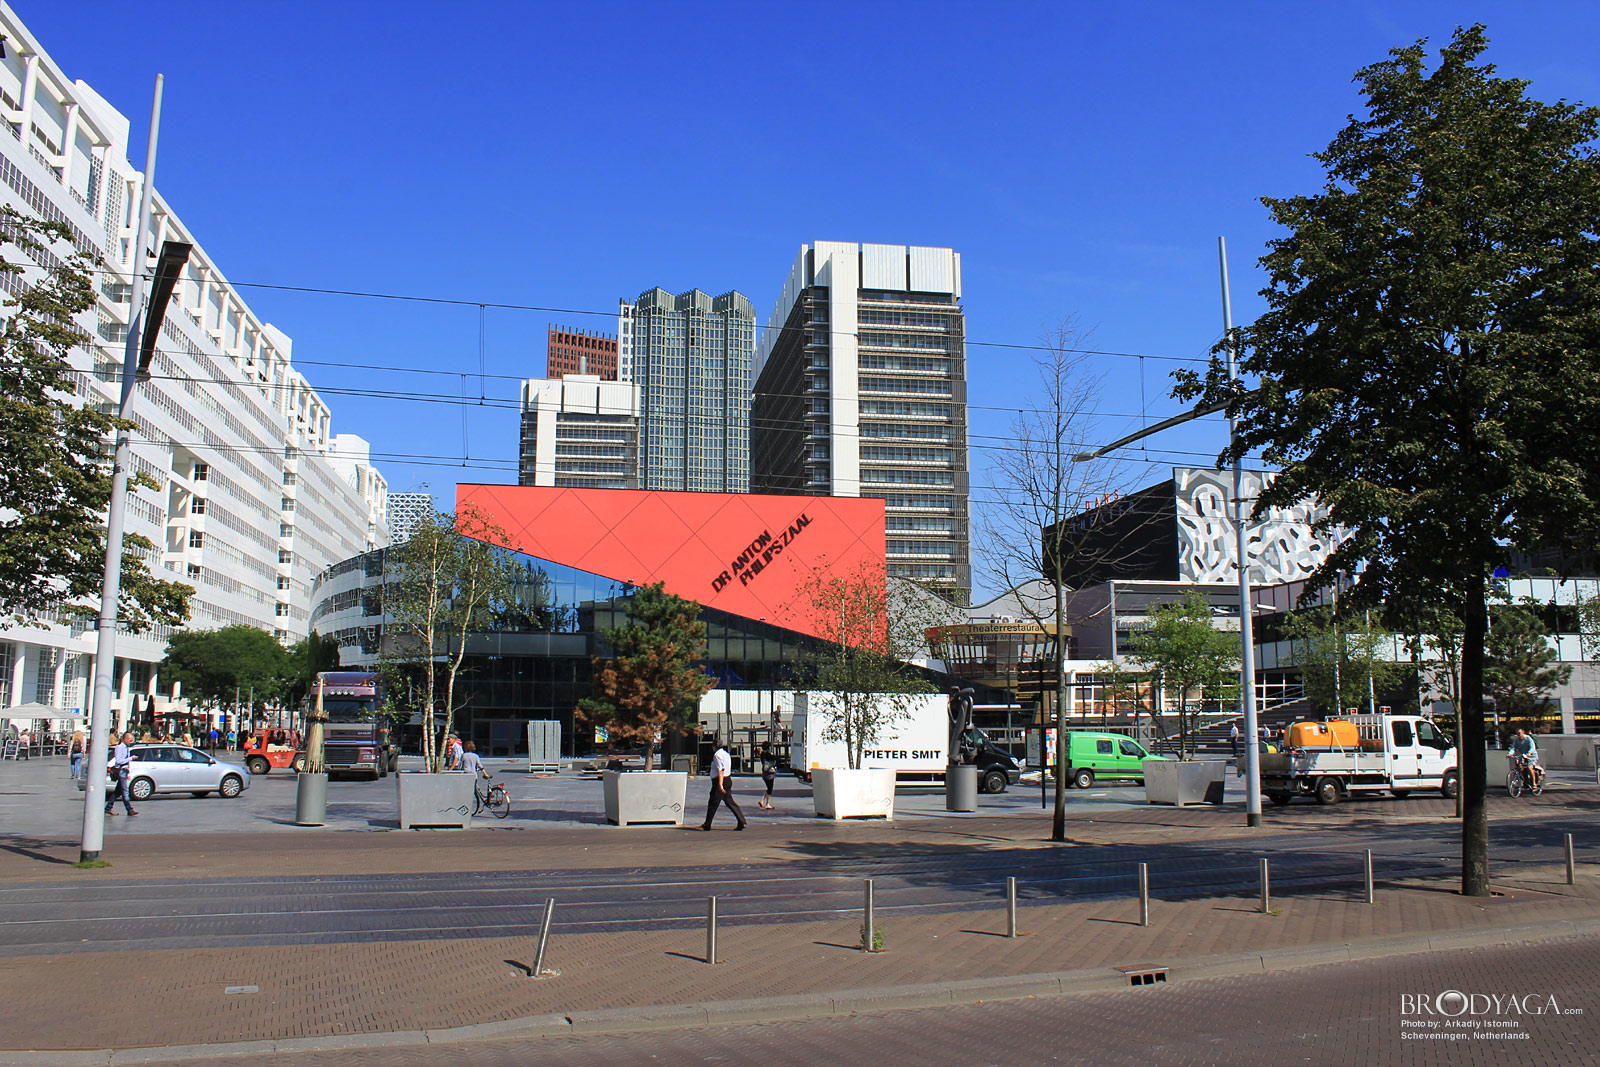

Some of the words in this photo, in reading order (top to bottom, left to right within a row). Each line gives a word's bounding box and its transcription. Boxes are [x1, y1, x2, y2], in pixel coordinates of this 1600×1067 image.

[711, 570, 732, 593] DR
[731, 529, 772, 577] ANTON
[864, 750, 908, 759] PIETER
[911, 750, 941, 759] SMIT
